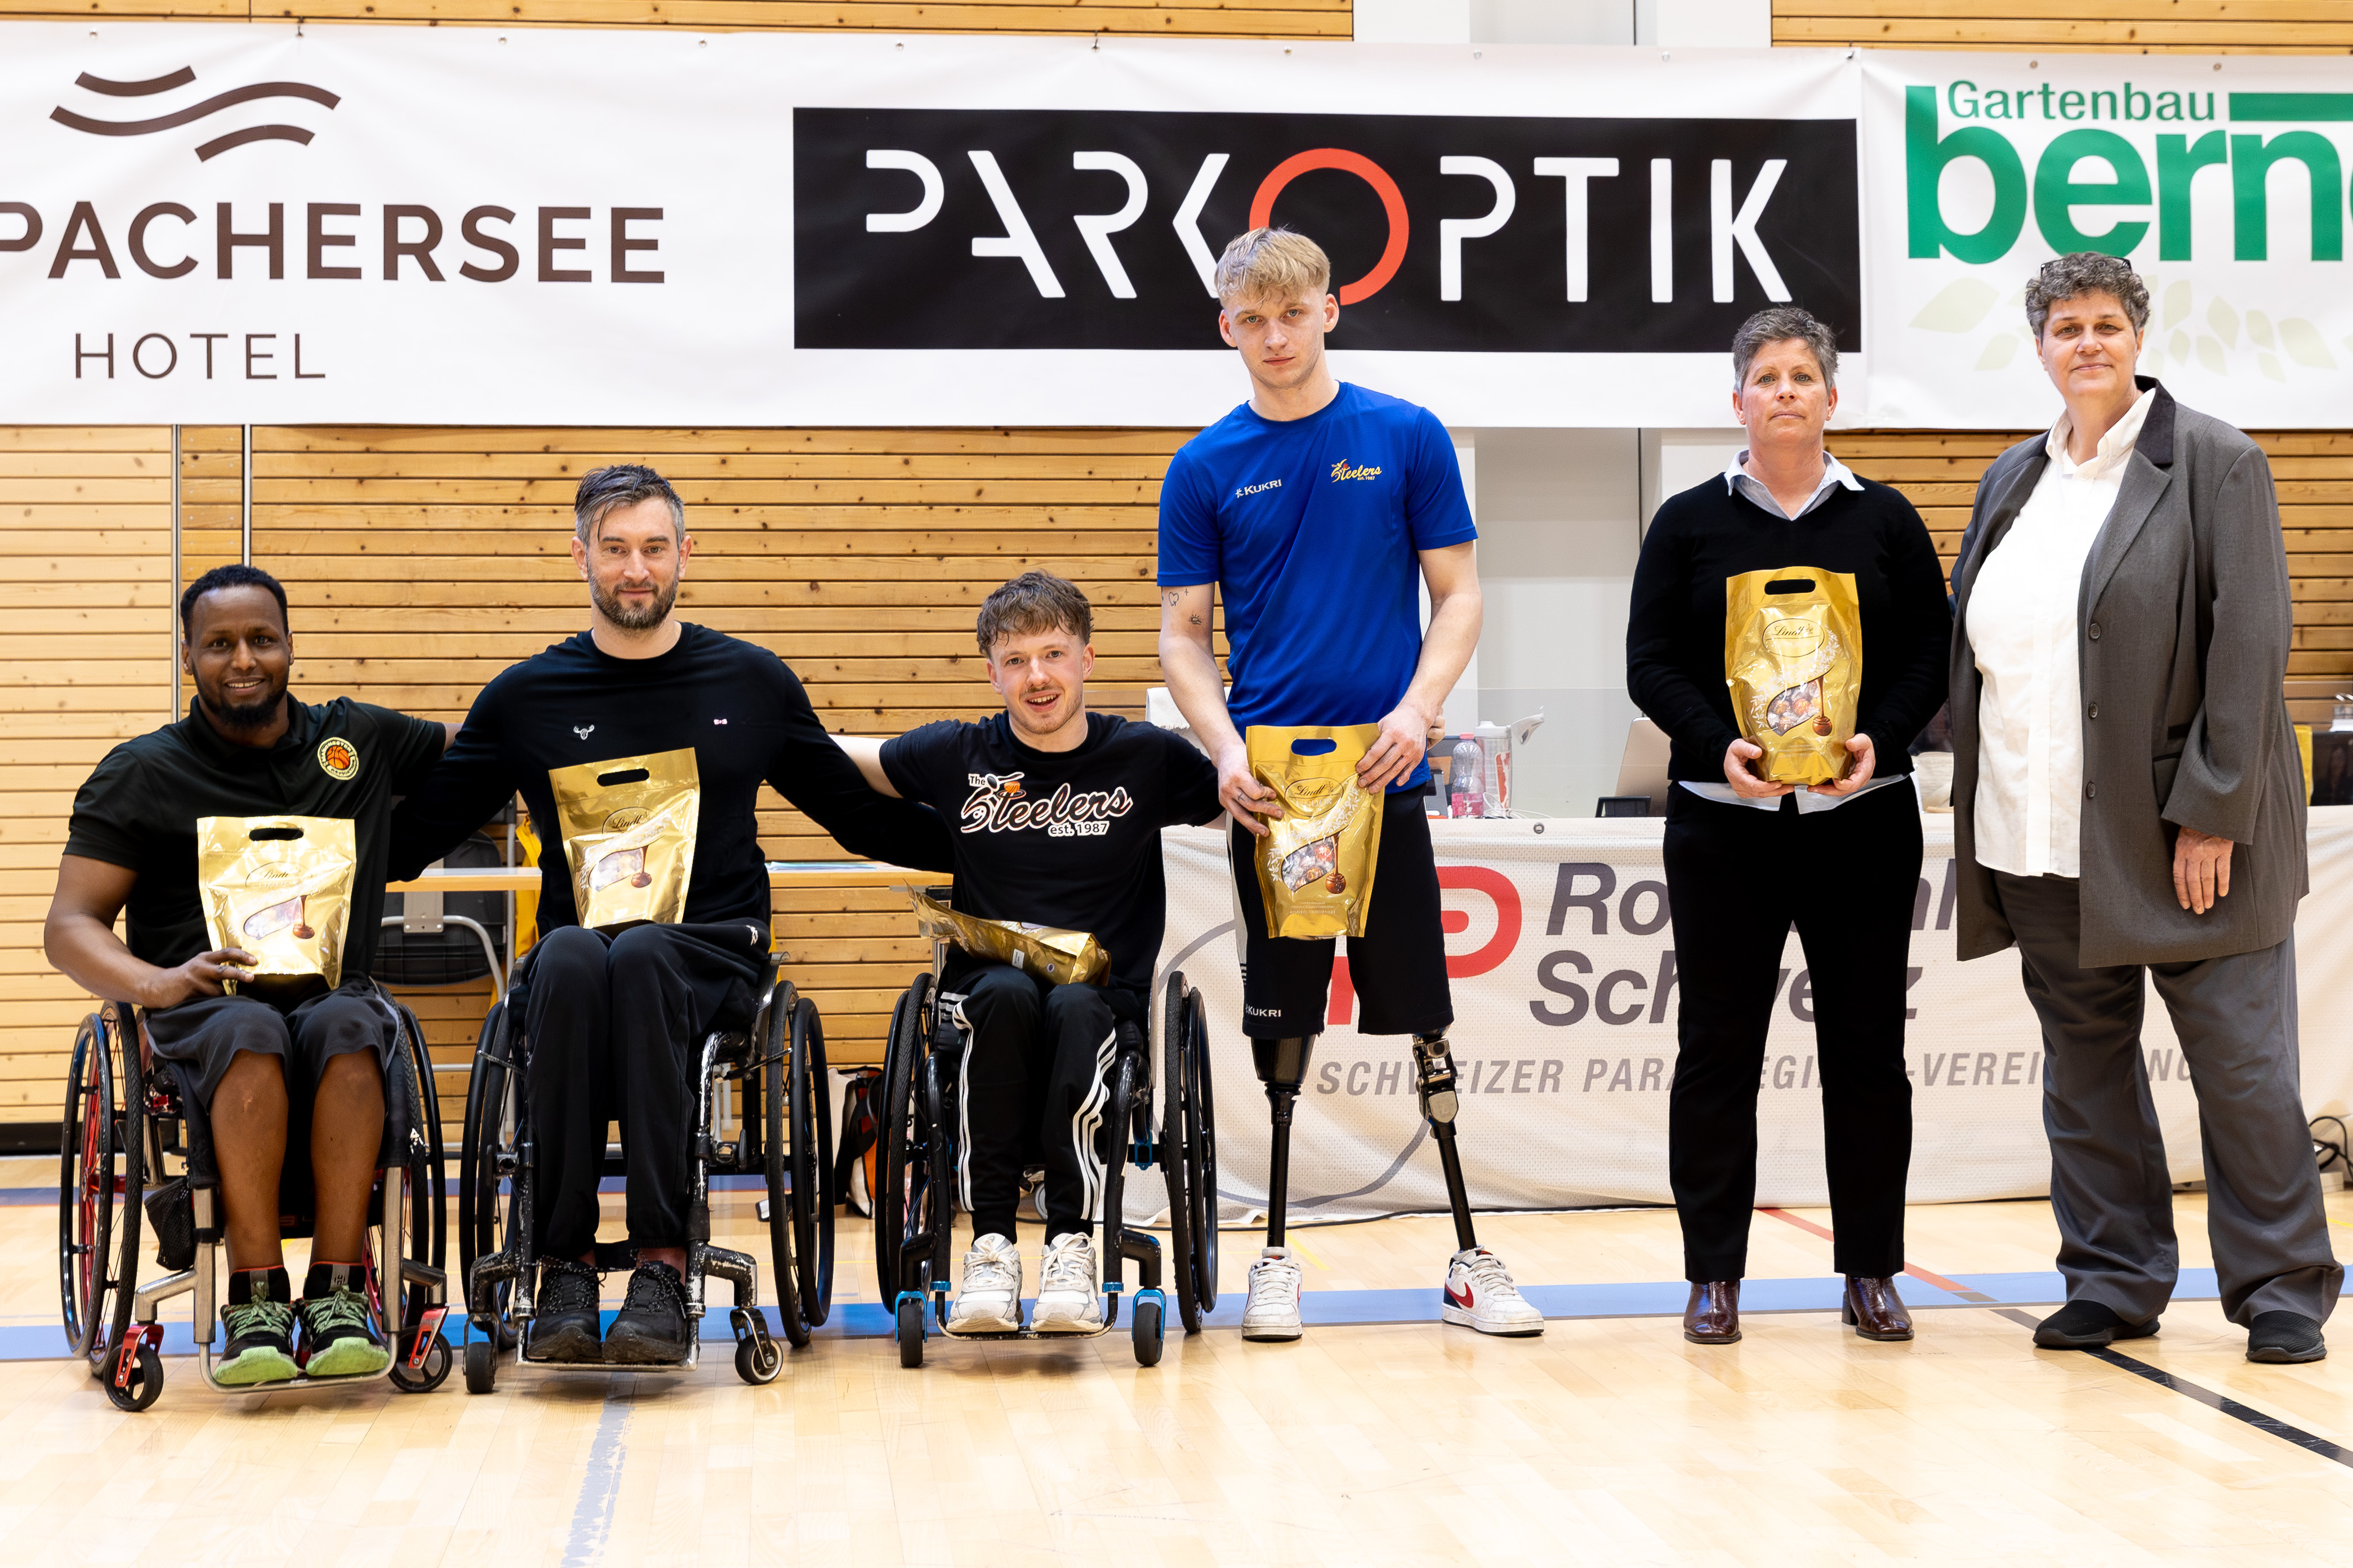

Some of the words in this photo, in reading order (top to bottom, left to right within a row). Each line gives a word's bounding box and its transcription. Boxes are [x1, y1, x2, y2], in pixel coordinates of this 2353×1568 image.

[1948, 79, 2216, 122] Gartenbau
[1905, 86, 2353, 265] bern
[866, 148, 1793, 306] PARKOPTIK
[74, 332, 326, 380] HOTEL
[1244, 479, 1282, 496] KUKRI
[1330, 461, 1383, 483] Steelers
[970, 775, 986, 785] The
[961, 780, 1133, 833] Steelers
[1050, 825, 1073, 834] est.
[1077, 823, 1108, 834] 1987
[1248, 1005, 1282, 1018] KUKRI
